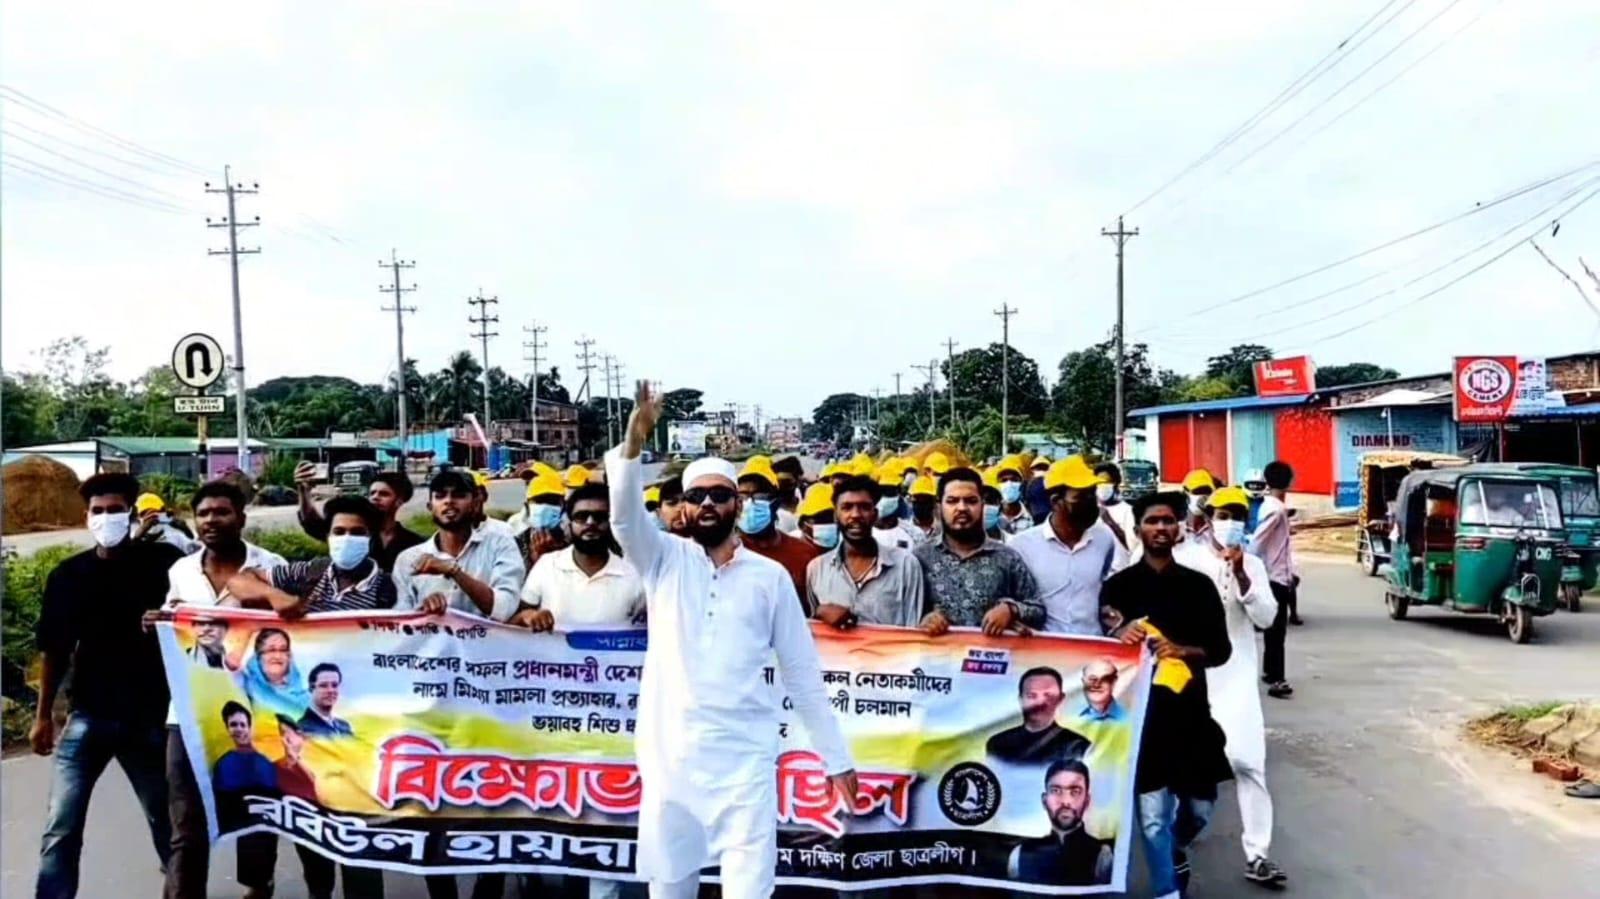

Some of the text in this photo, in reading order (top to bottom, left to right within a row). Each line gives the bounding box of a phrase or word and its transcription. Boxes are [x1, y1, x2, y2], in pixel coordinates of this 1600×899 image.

[1466, 389, 1504, 401] CEMENT
[1351, 434, 1411, 448] DIAMOND
[372, 652, 461, 673] বাংলাদেশের
[513, 656, 600, 682] প্রধানমন্ত্রী
[605, 664, 643, 682] দেশ
[822, 670, 850, 687] কল
[854, 699, 911, 718] চলমান
[586, 712, 622, 733] শিশু
[379, 735, 642, 816] বিক্ষোভ
[246, 795, 639, 868] রবিউল হায়দা
[799, 844, 845, 871] দক্ষিণ
[851, 849, 895, 870] জেলা
[899, 840, 965, 868] ছাত্রলীগ
